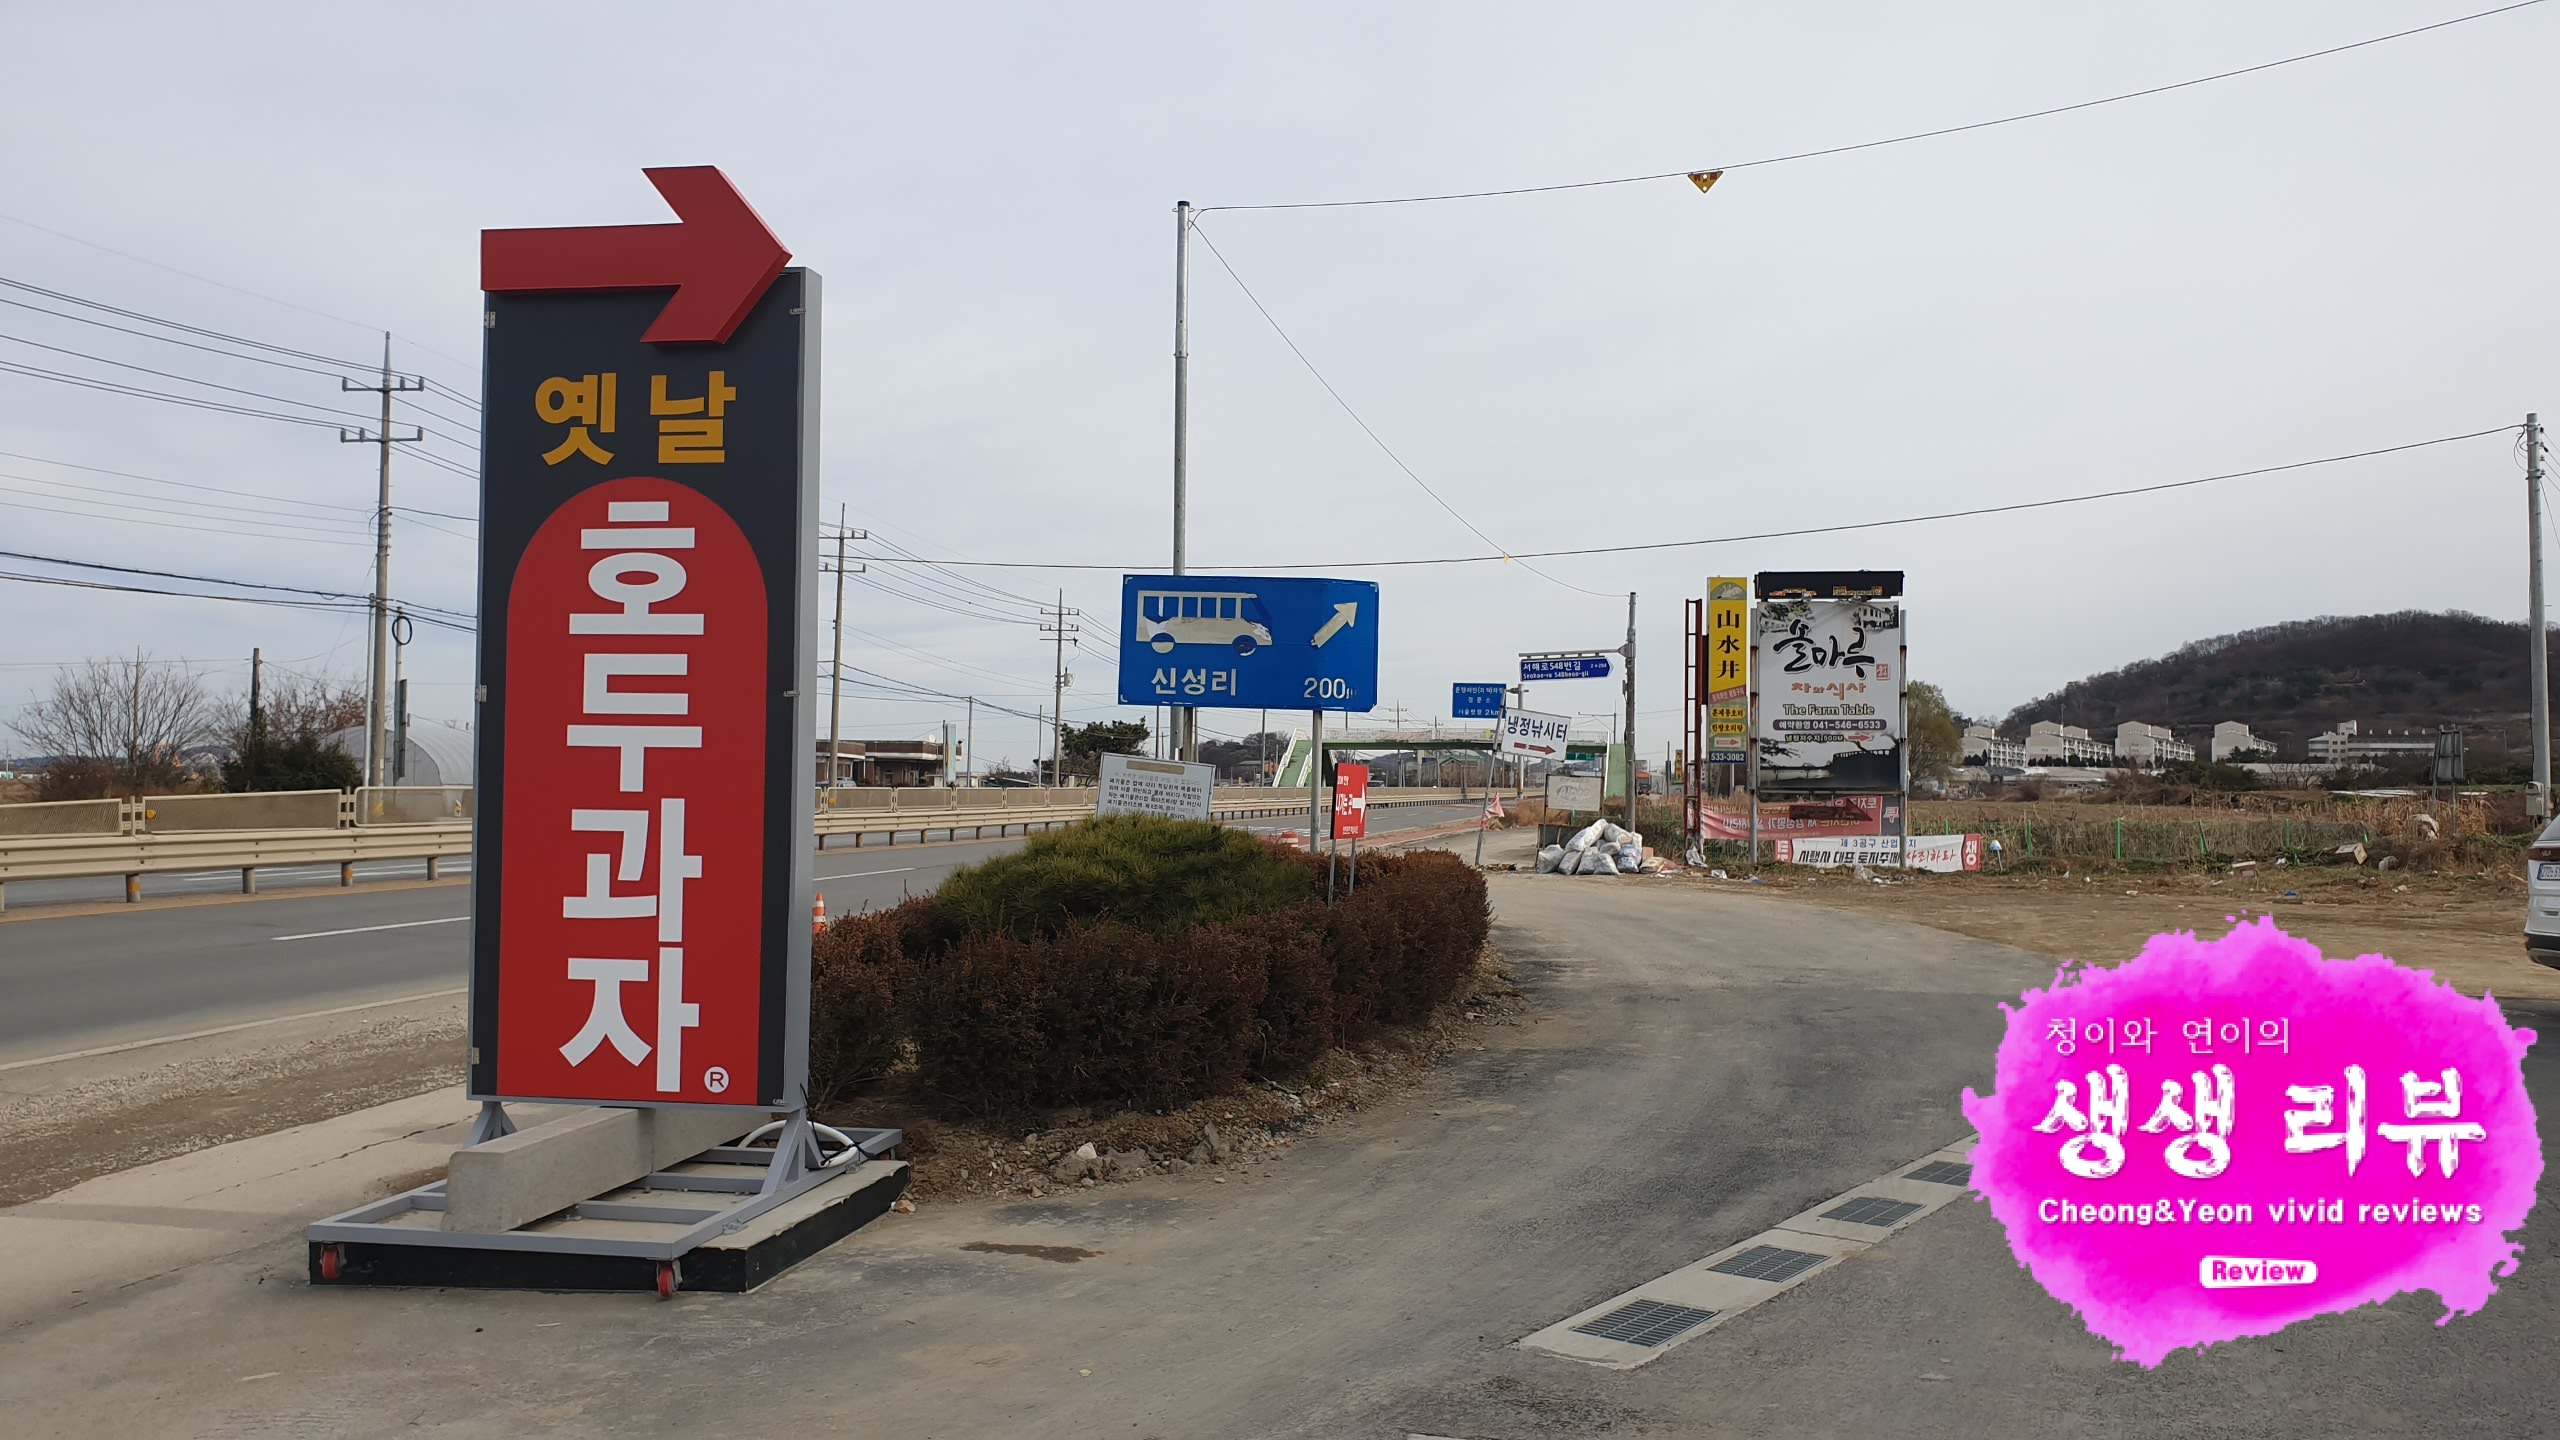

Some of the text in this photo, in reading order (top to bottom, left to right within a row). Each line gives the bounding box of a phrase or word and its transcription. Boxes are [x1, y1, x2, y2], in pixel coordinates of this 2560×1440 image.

[535, 370, 737, 466] 옛날
[1716, 609, 1740, 679] 山水井
[1773, 619, 1875, 678] 솔마루
[1523, 661, 1581, 671] 서해로548번길
[1151, 667, 1237, 697] 신성리
[1783, 704, 1875, 715] The Farm Table
[1507, 715, 1568, 743] 냉정낚시터
[1779, 720, 1881, 730] 예약환영 041-546-6533
[1711, 753, 1745, 761] 533-3082
[558, 501, 704, 1093] 호두과자
[1799, 850, 1831, 864] 시행사
[1833, 851, 1855, 864] 대표
[1906, 849, 1957, 863] 사죄하라
[1840, 838, 1917, 848] 제 3공구 산업지
[1965, 840, 1978, 867] 쟁
